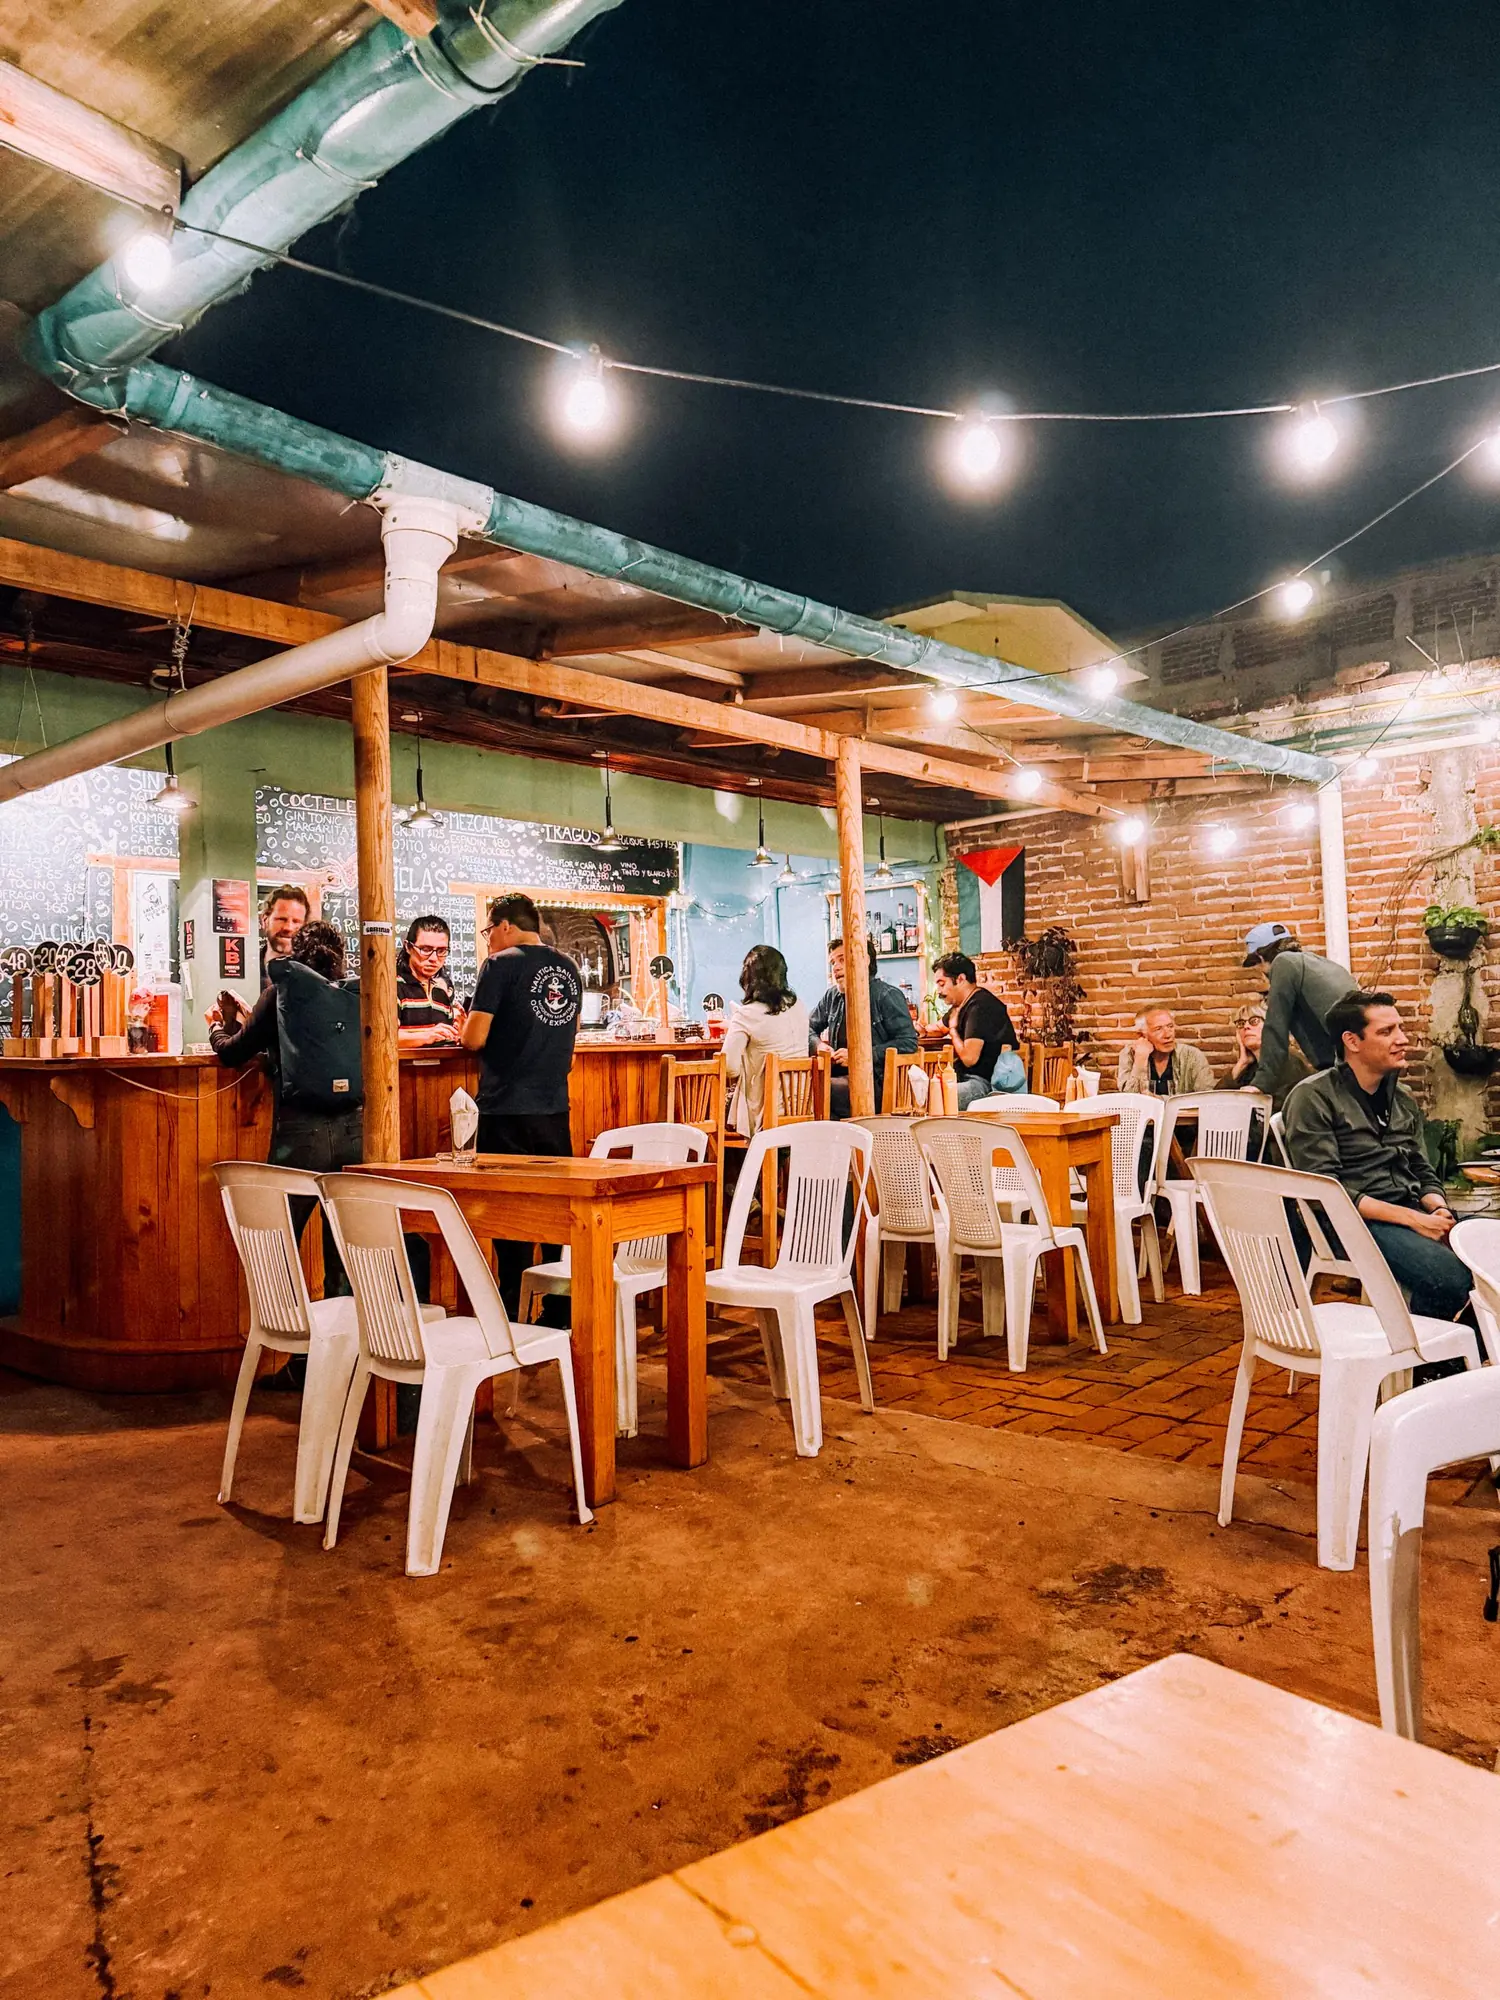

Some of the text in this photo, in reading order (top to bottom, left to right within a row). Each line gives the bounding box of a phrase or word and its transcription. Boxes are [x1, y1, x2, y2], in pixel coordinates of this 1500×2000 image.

[128, 771, 161, 791] SIN
[130, 791, 156, 802] AGU
[279, 793, 357, 813] COCTELE
[131, 811, 179, 826] KOMBUC
[284, 810, 305, 822] GIN
[308, 812, 343, 826] TONIC
[449, 812, 499, 834] MEZCAL
[131, 824, 167, 836] KEFIR
[285, 821, 350, 836] MARGARITA
[0, 831, 49, 854] NAS
[286, 831, 346, 846] CARAJILLO
[392, 839, 423, 853] OJITO
[130, 846, 178, 858] CHOCOL
[0, 867, 25, 879] TAS
[620, 862, 637, 870] VINO
[621, 868, 640, 877] TINTO
[10, 879, 56, 892] TOCINO
[394, 866, 449, 895] ELAS
[0, 889, 46, 901] FRAGIO
[21, 920, 112, 941] SALCHICHAS
[462, 922, 475, 934] 265
[40, 947, 56, 966] 20
[225, 938, 241, 965] KB
[8, 952, 27, 971] 48
[75, 958, 97, 978] 28
[659, 959, 664, 974] 1
[530, 965, 555, 993] NAUTICA
[709, 996, 719, 1010] 41
[530, 999, 549, 1024] OCEAN
